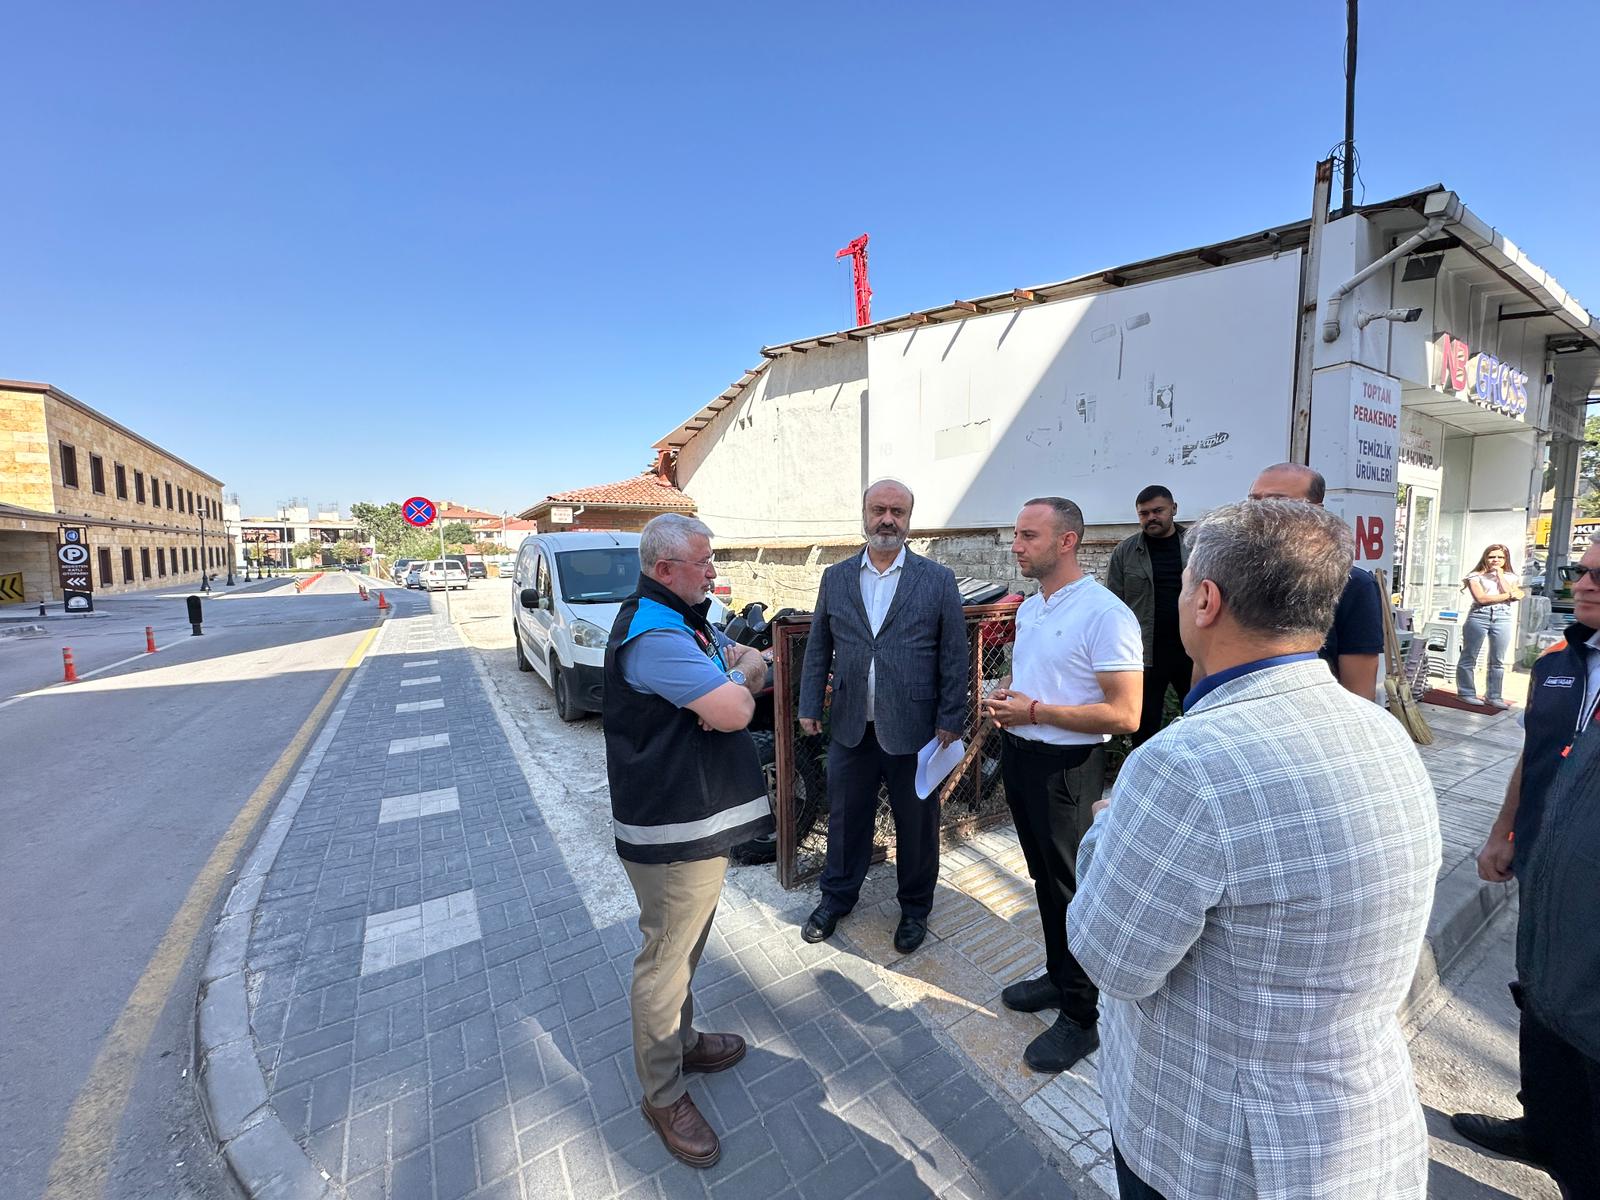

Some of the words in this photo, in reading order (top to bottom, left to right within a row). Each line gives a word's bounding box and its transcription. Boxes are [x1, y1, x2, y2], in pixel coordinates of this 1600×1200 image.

[1441, 333, 1469, 391] NB
[1475, 352, 1528, 414] GROSS
[1363, 382, 1391, 404] TOPTAN
[1353, 405, 1397, 429] PERAKENDE
[1358, 439, 1392, 460] TEMİZLİK
[1355, 460, 1393, 483] ÜRÜNLERİ
[1355, 515, 1384, 560] NB
[68, 549, 80, 560] P
